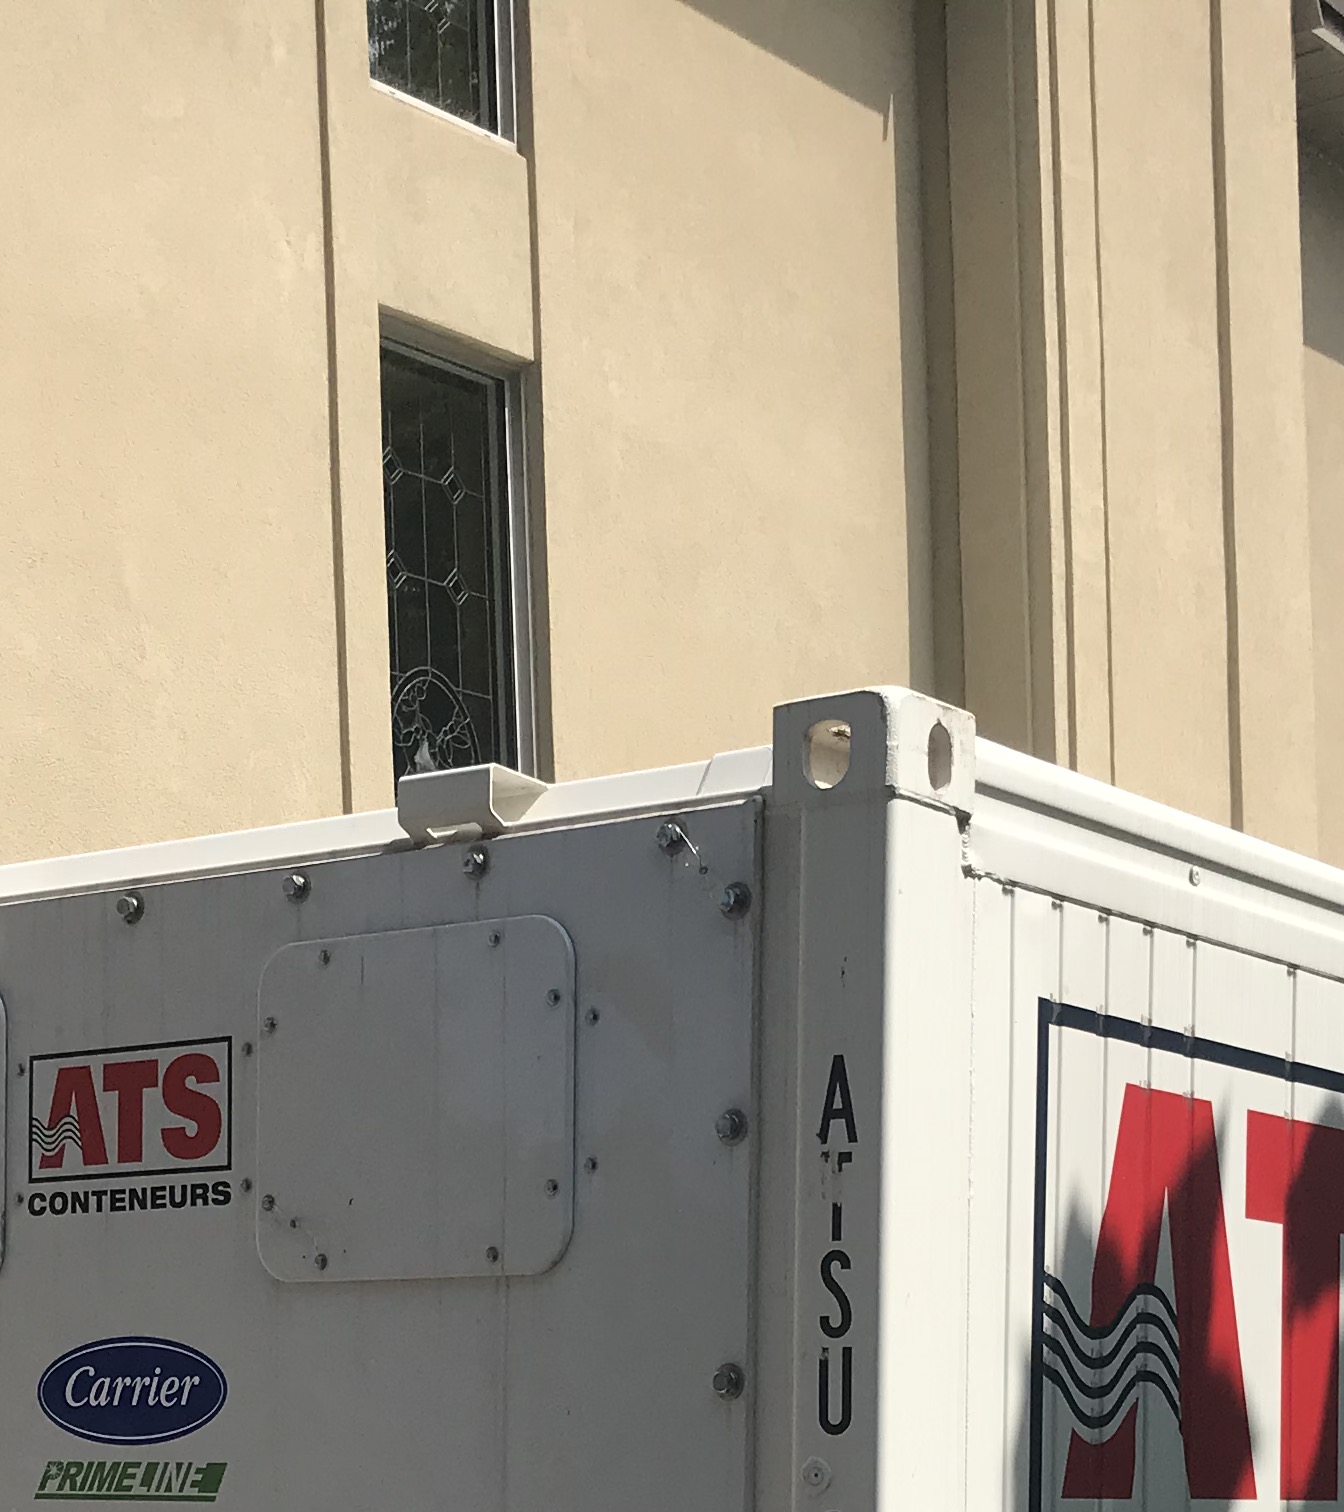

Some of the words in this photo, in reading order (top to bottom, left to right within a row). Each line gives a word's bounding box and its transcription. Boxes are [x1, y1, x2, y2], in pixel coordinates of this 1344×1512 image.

[39, 1052, 222, 1170] ATS
[27, 1181, 233, 1216] CONTENEURS
[64, 1365, 201, 1409] Carrier
